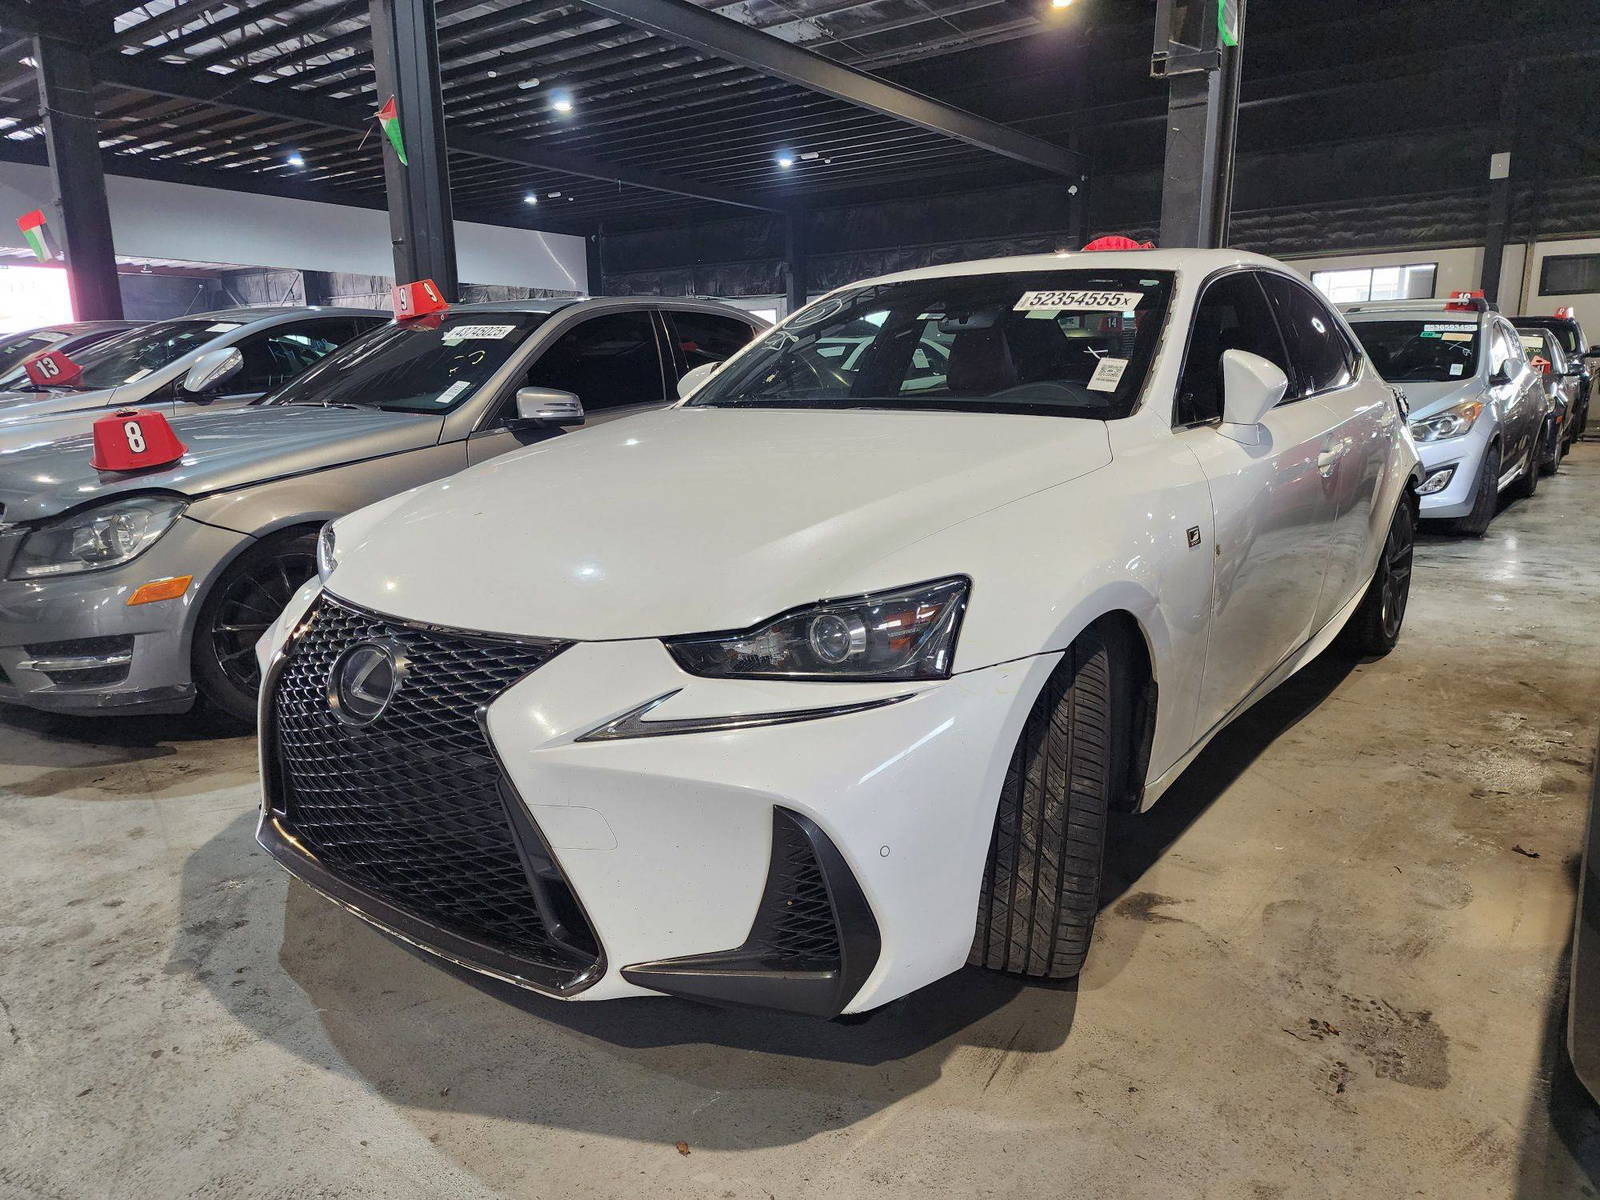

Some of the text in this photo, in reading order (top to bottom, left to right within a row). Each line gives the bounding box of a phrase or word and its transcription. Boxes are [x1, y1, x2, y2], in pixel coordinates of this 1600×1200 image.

[400, 288, 408, 311] 9
[423, 282, 438, 302] 9
[1107, 317, 1117, 328] 14
[36, 356, 60, 379] 13
[124, 420, 147, 454] 8
